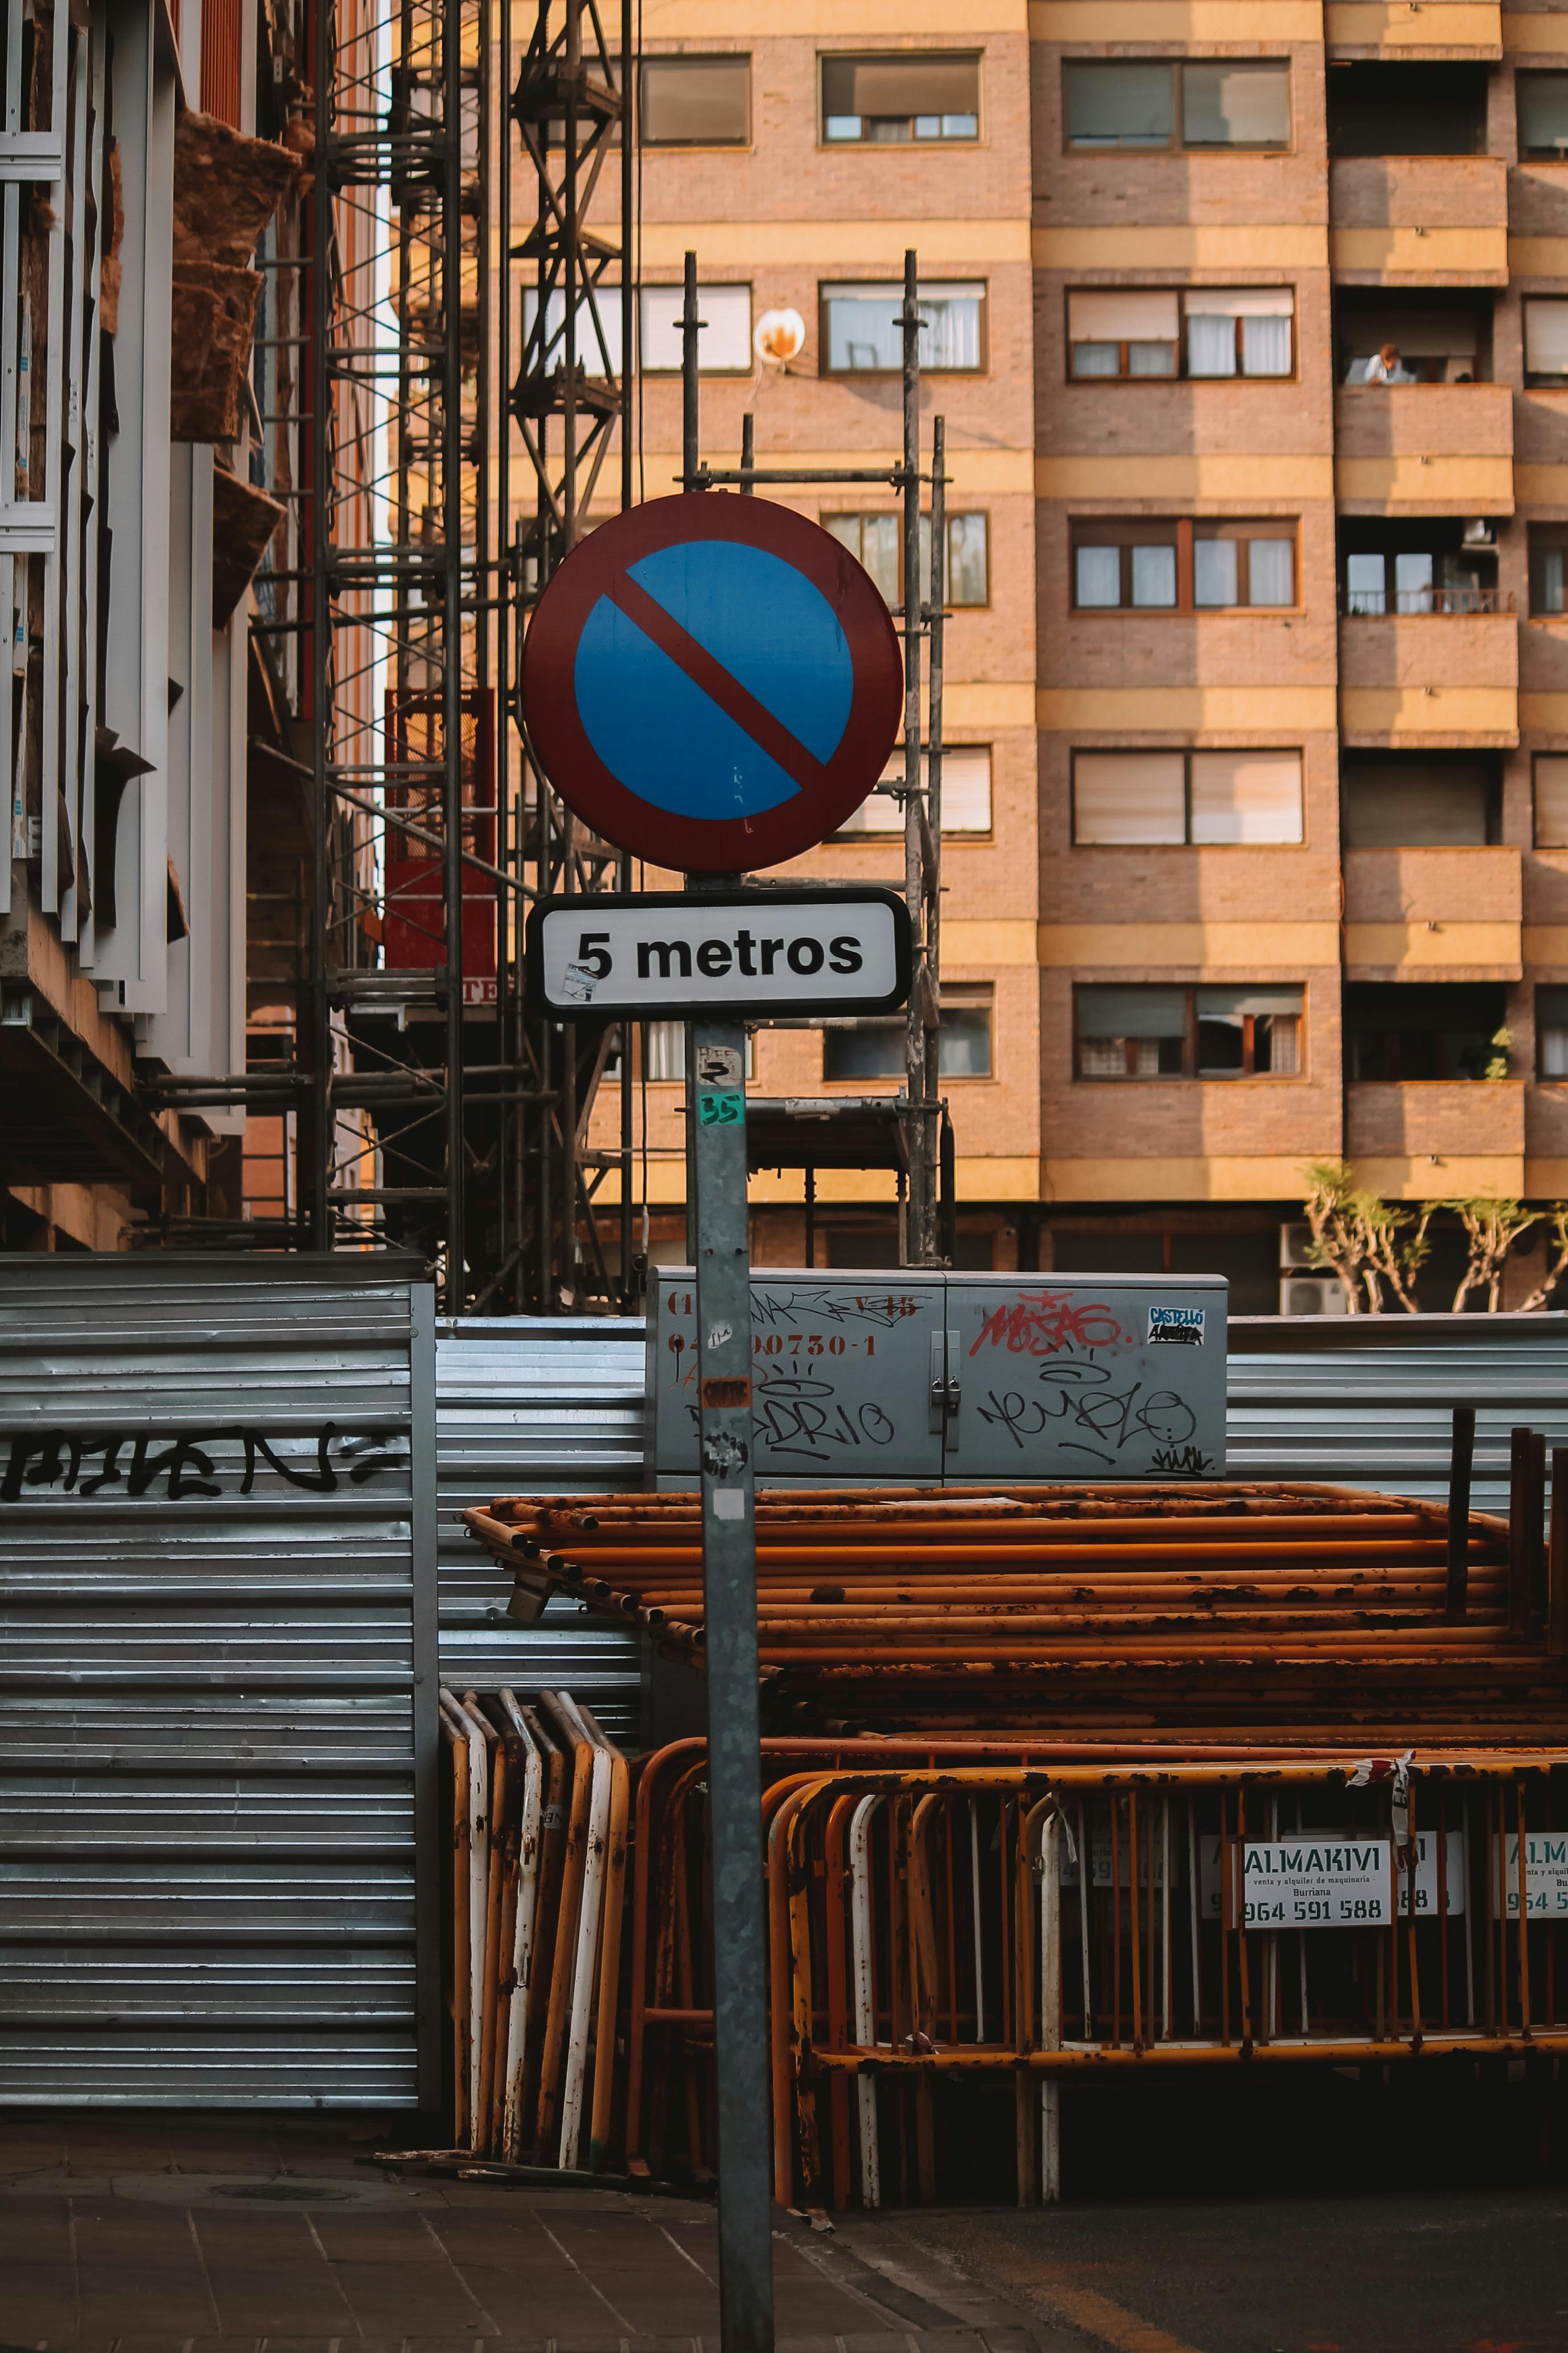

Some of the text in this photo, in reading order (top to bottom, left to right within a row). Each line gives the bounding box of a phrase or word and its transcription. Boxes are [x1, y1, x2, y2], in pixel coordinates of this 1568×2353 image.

[578, 930, 862, 980] 5 metros
[1245, 1847, 1379, 1874] ALMAKIVI
[1285, 1877, 1313, 1886] alquiler
[1328, 1875, 1370, 1885] maquinaria
[1293, 1887, 1331, 1897] Burriana
[1245, 1899, 1381, 1922] 964 591 588
